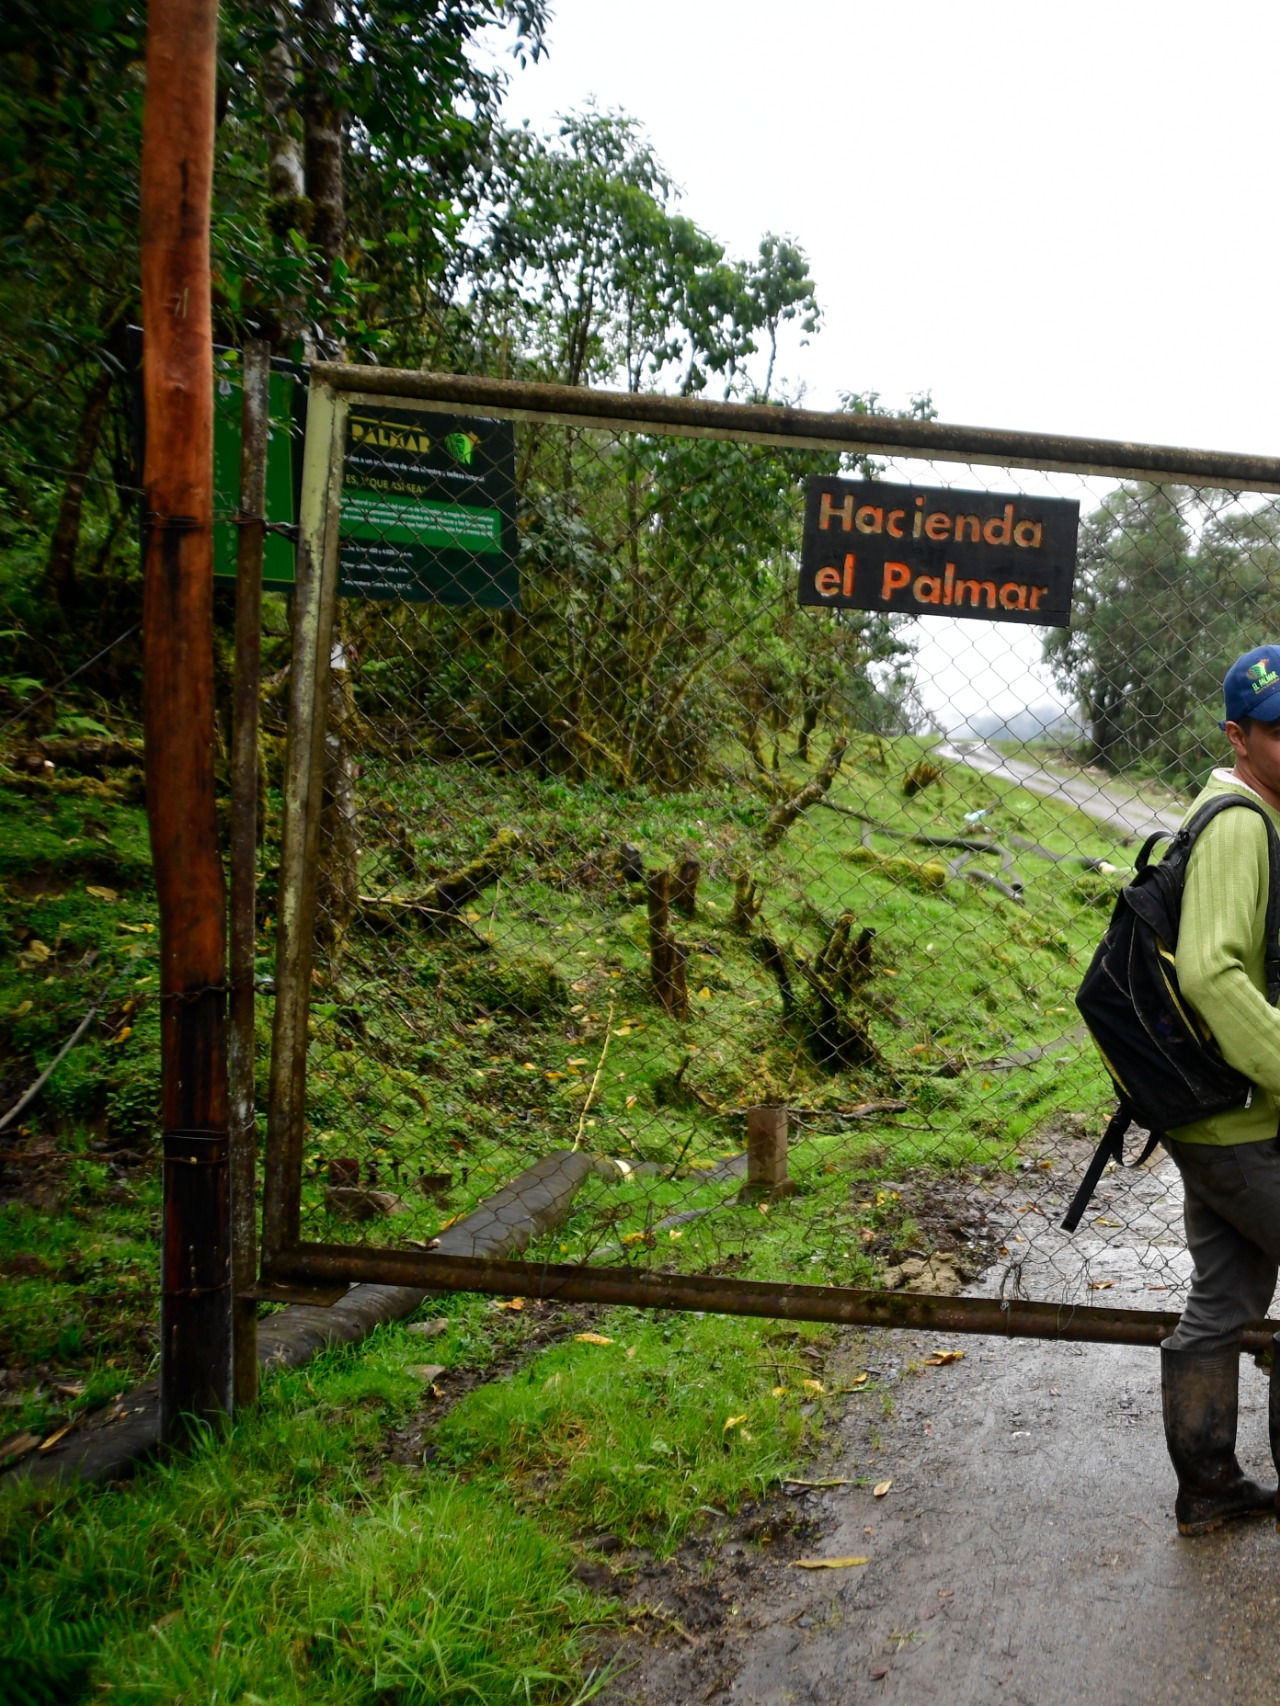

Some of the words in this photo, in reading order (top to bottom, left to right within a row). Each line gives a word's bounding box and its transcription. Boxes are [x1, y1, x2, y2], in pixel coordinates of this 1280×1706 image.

[352, 423, 431, 454] PALMAR
[820, 492, 1042, 548] Hacienda
[815, 553, 856, 597] el
[882, 560, 1048, 611] Palmar
